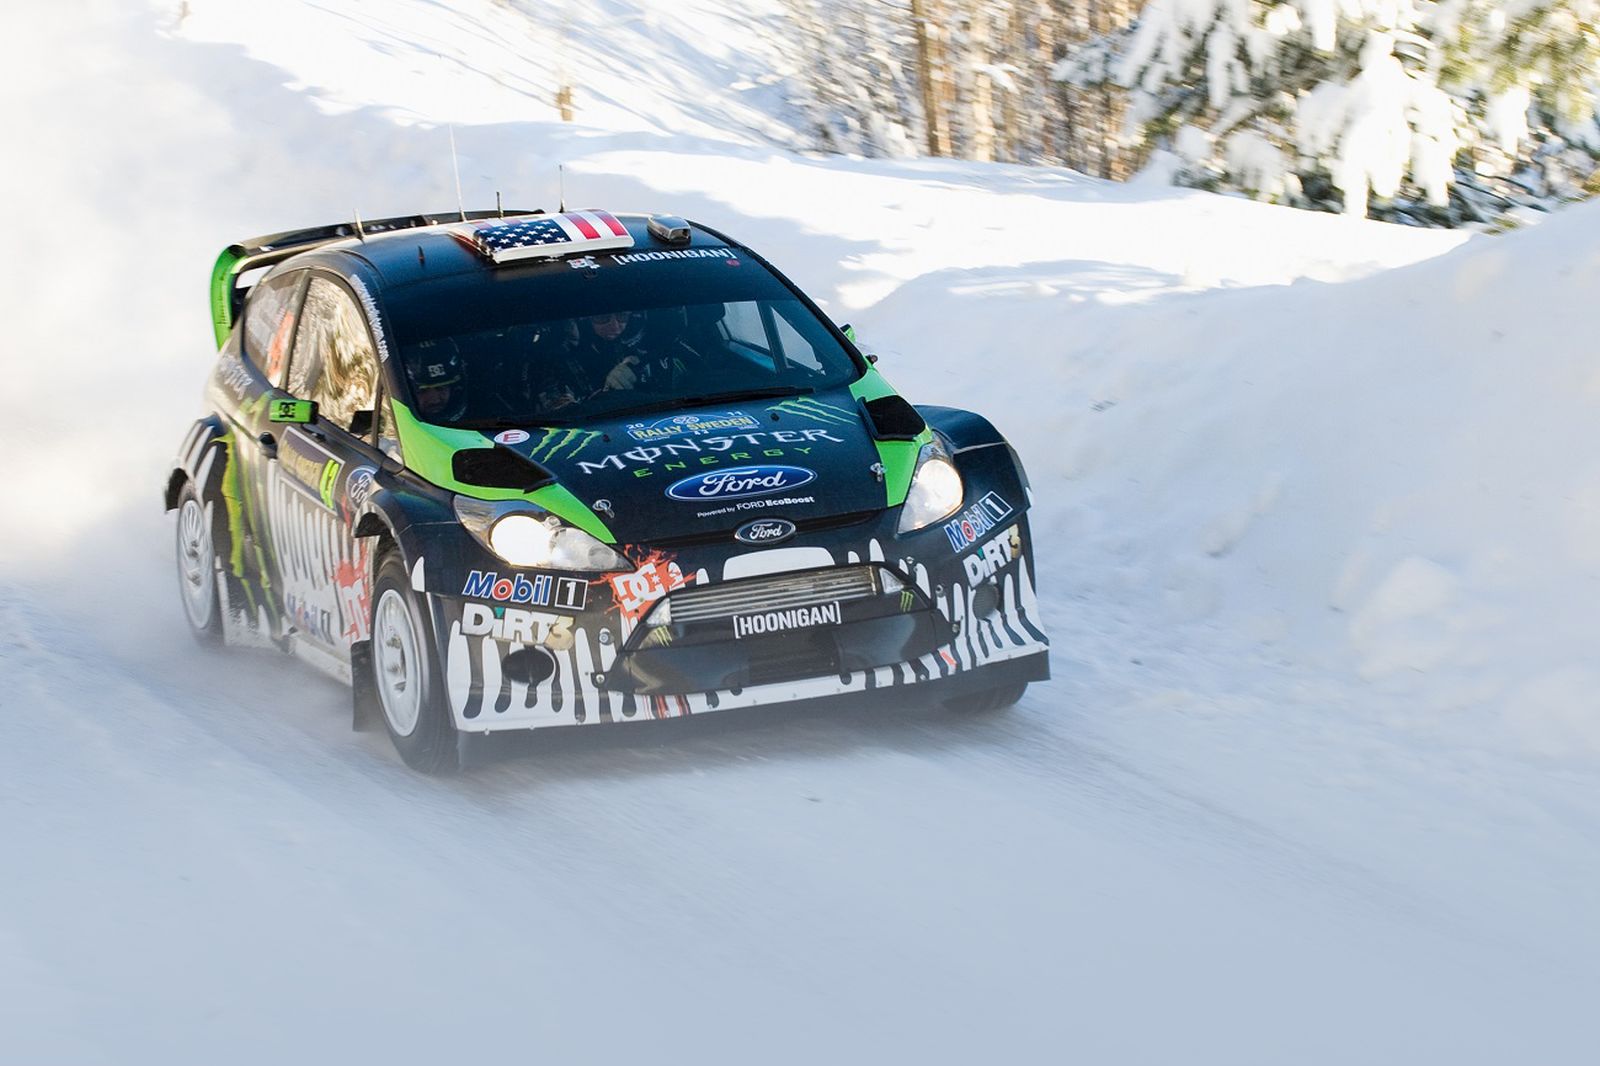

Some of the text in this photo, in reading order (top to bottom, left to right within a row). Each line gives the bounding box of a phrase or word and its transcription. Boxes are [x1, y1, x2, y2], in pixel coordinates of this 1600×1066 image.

[503, 432, 521, 443] E
[633, 416, 754, 440] RALLY SWEDEN
[633, 447, 812, 478] ENERGY
[699, 469, 788, 497] Ford
[697, 507, 726, 518] Powered
[736, 500, 765, 510] FORD
[765, 496, 815, 507] EcoBoost
[749, 523, 783, 540] Ford
[943, 503, 996, 554] Mobil
[462, 570, 553, 607] Mobil
[612, 562, 666, 612] DC
